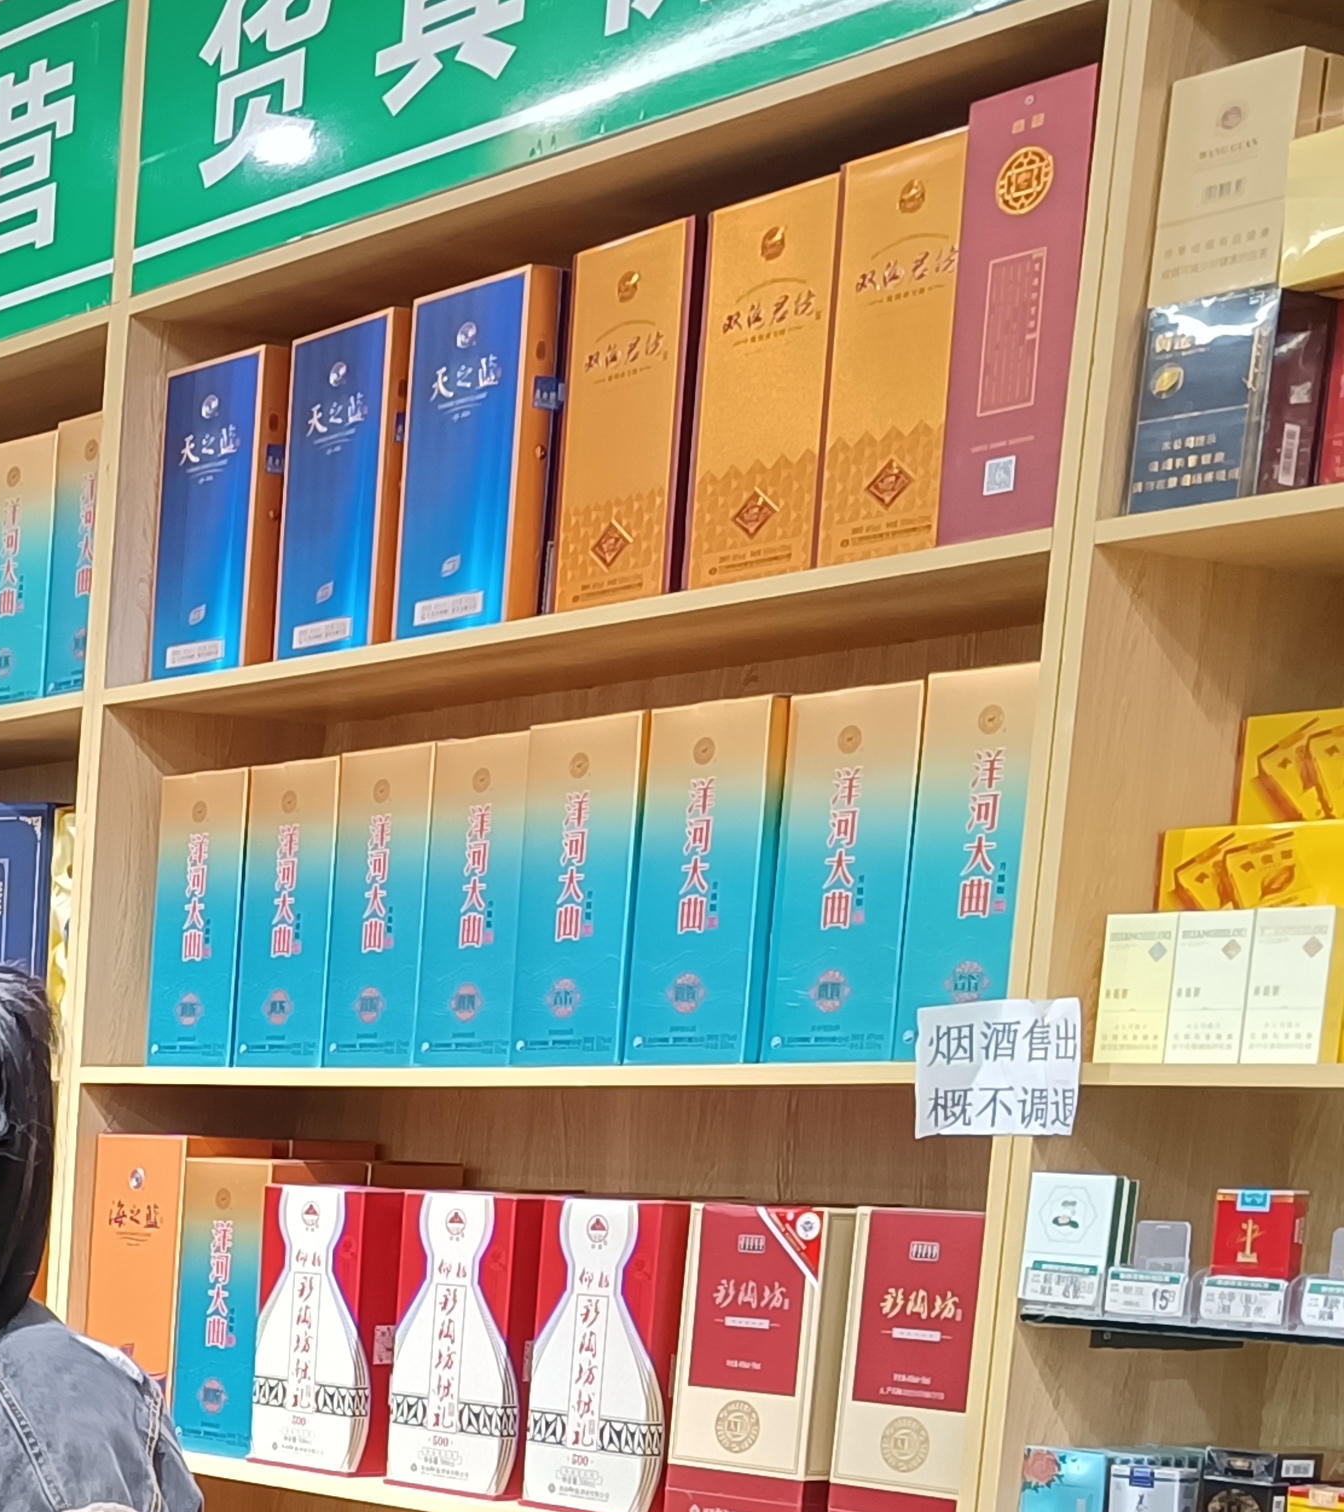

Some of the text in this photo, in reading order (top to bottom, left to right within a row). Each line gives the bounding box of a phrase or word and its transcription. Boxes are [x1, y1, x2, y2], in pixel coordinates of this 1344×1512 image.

[180, 832, 210, 962] 洋河大曲
[270, 823, 301, 959] 洋河大曲
[360, 813, 393, 953] 洋河大曲
[458, 803, 492, 950] 洋河大曲
[554, 790, 592, 943] 洋河大曲
[676, 776, 716, 936] 洋河大曲
[820, 765, 864, 931] 洋河大曲
[956, 746, 1005, 920] 洋河大曲
[926, 1017, 1079, 1068] 烟酒售出
[927, 1086, 1075, 1130] 概不调退
[205, 1218, 234, 1350] 洋河大曲
